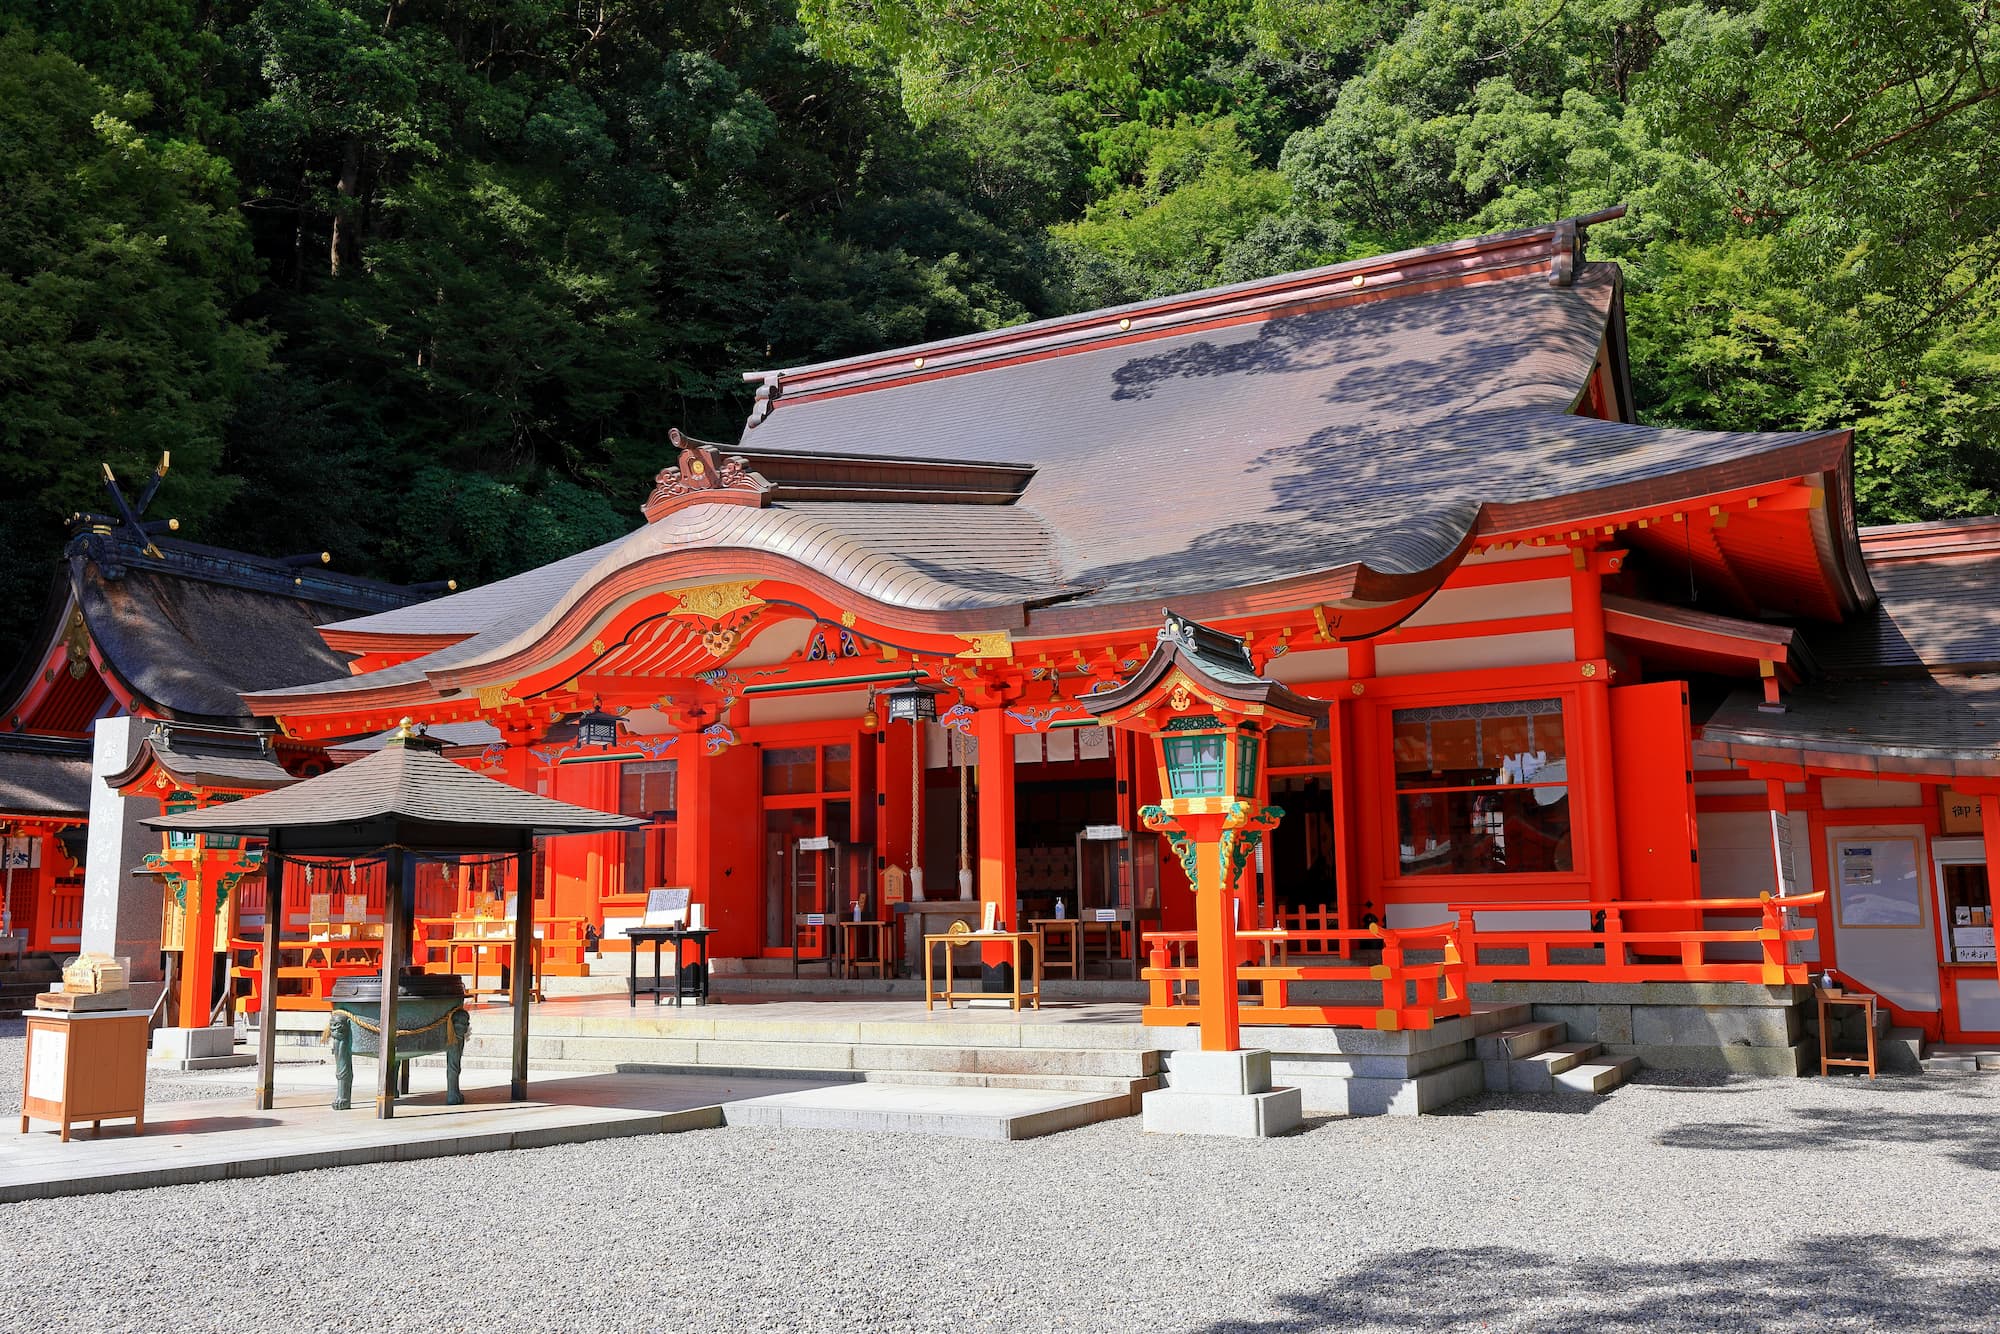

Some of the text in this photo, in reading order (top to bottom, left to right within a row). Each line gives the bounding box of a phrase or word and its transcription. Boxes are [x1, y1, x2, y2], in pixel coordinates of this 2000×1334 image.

[90, 740, 119, 931] 熊那智大社
